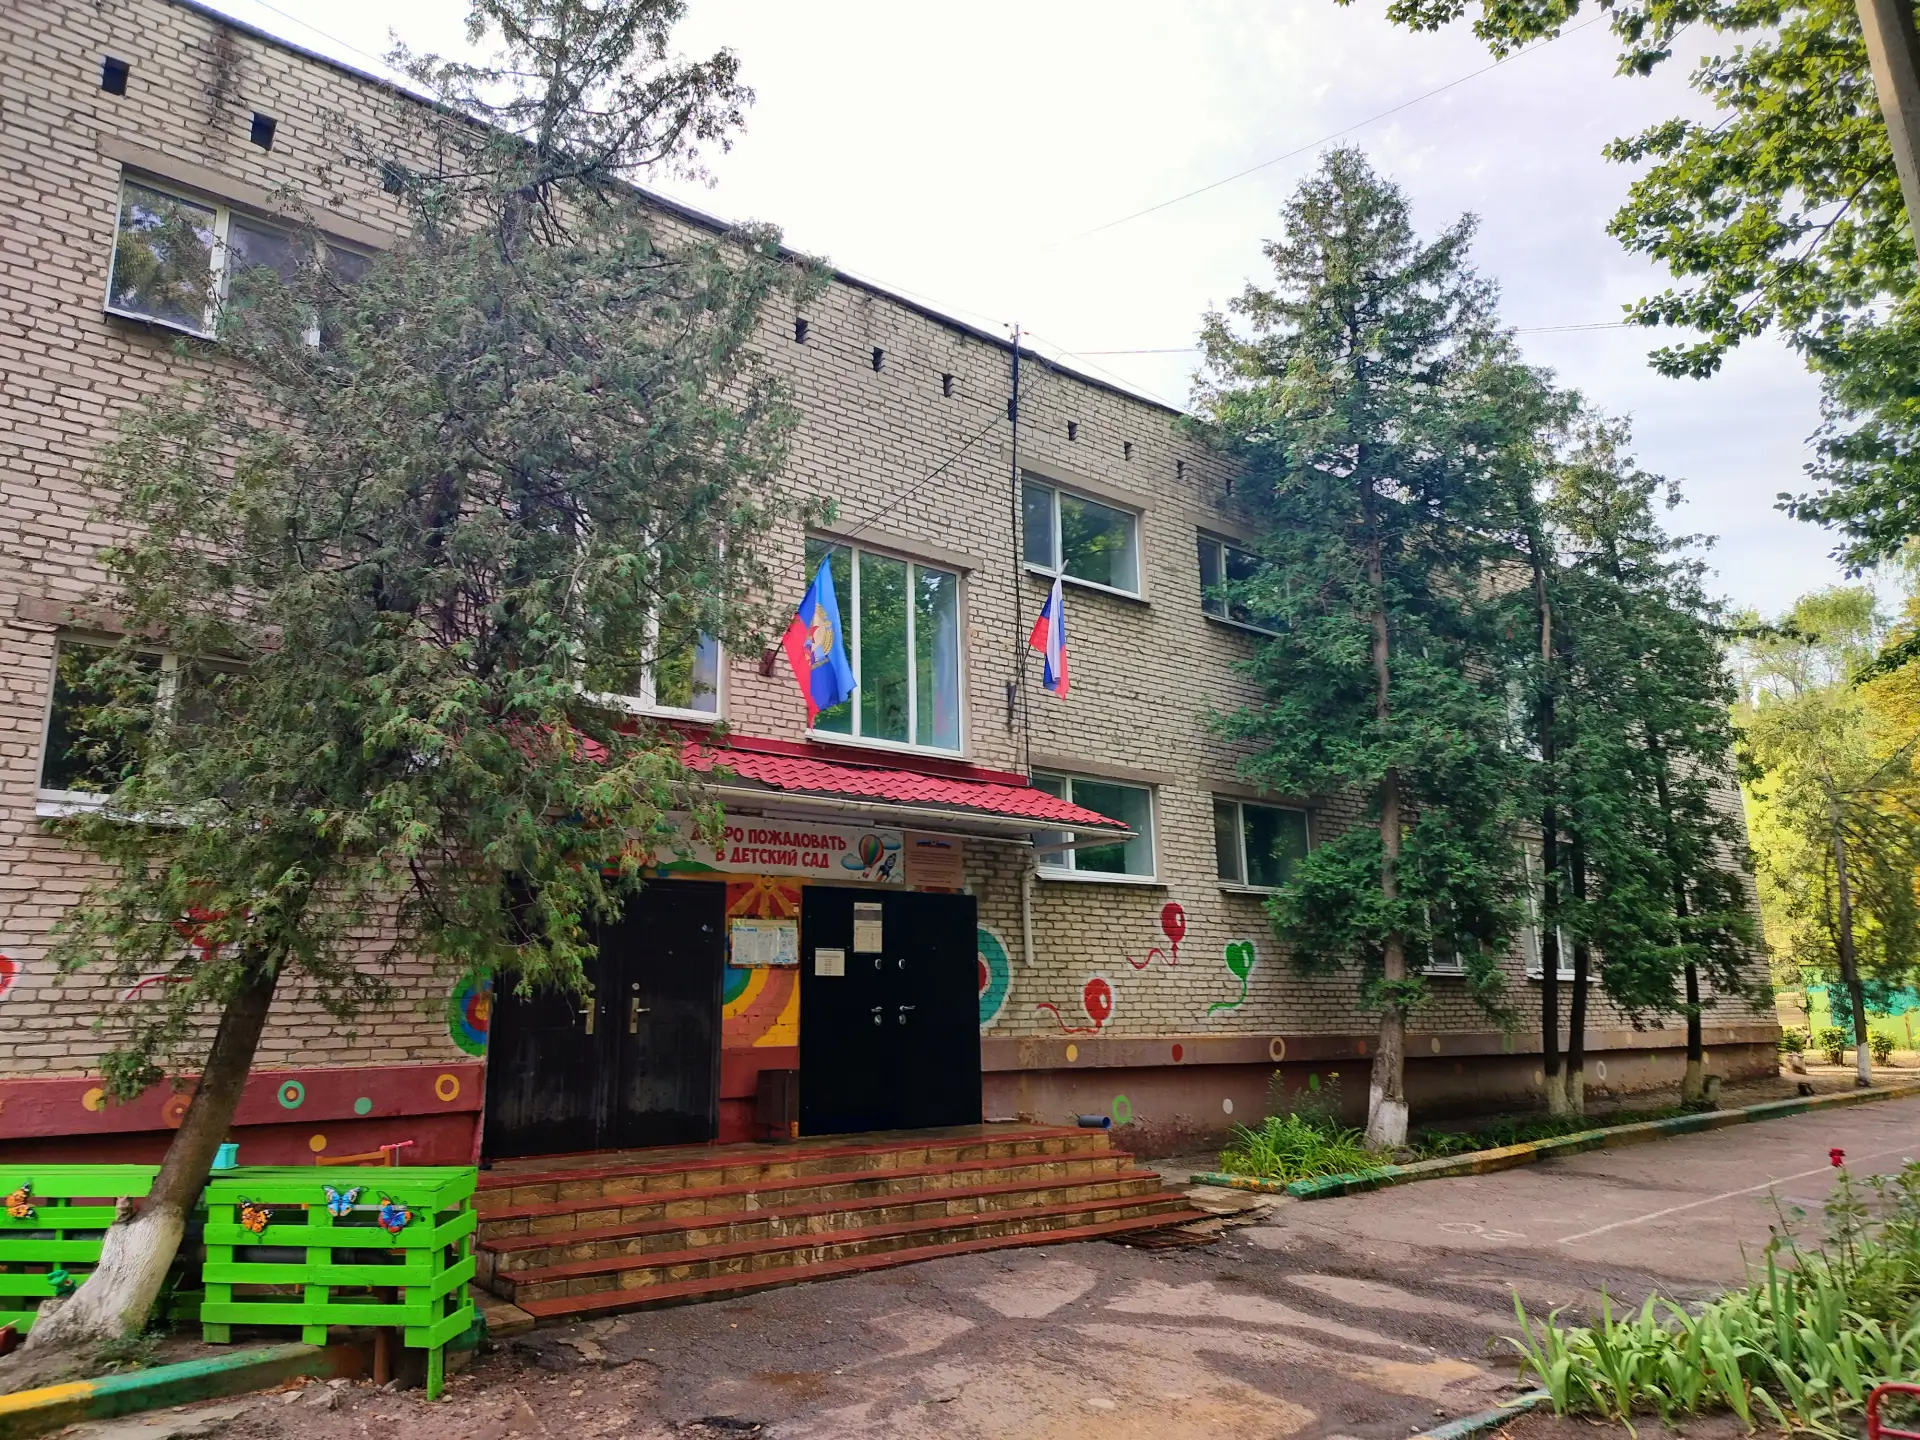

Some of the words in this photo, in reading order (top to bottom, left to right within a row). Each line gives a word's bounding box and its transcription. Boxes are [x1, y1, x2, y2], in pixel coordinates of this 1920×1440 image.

[690, 826, 744, 843] ДРО
[748, 829, 847, 850] ПОЖАЛОВАТЬ
[715, 847, 726, 862] В
[730, 847, 798, 867] ДЕТСКИЙ
[801, 851, 830, 869] САД
